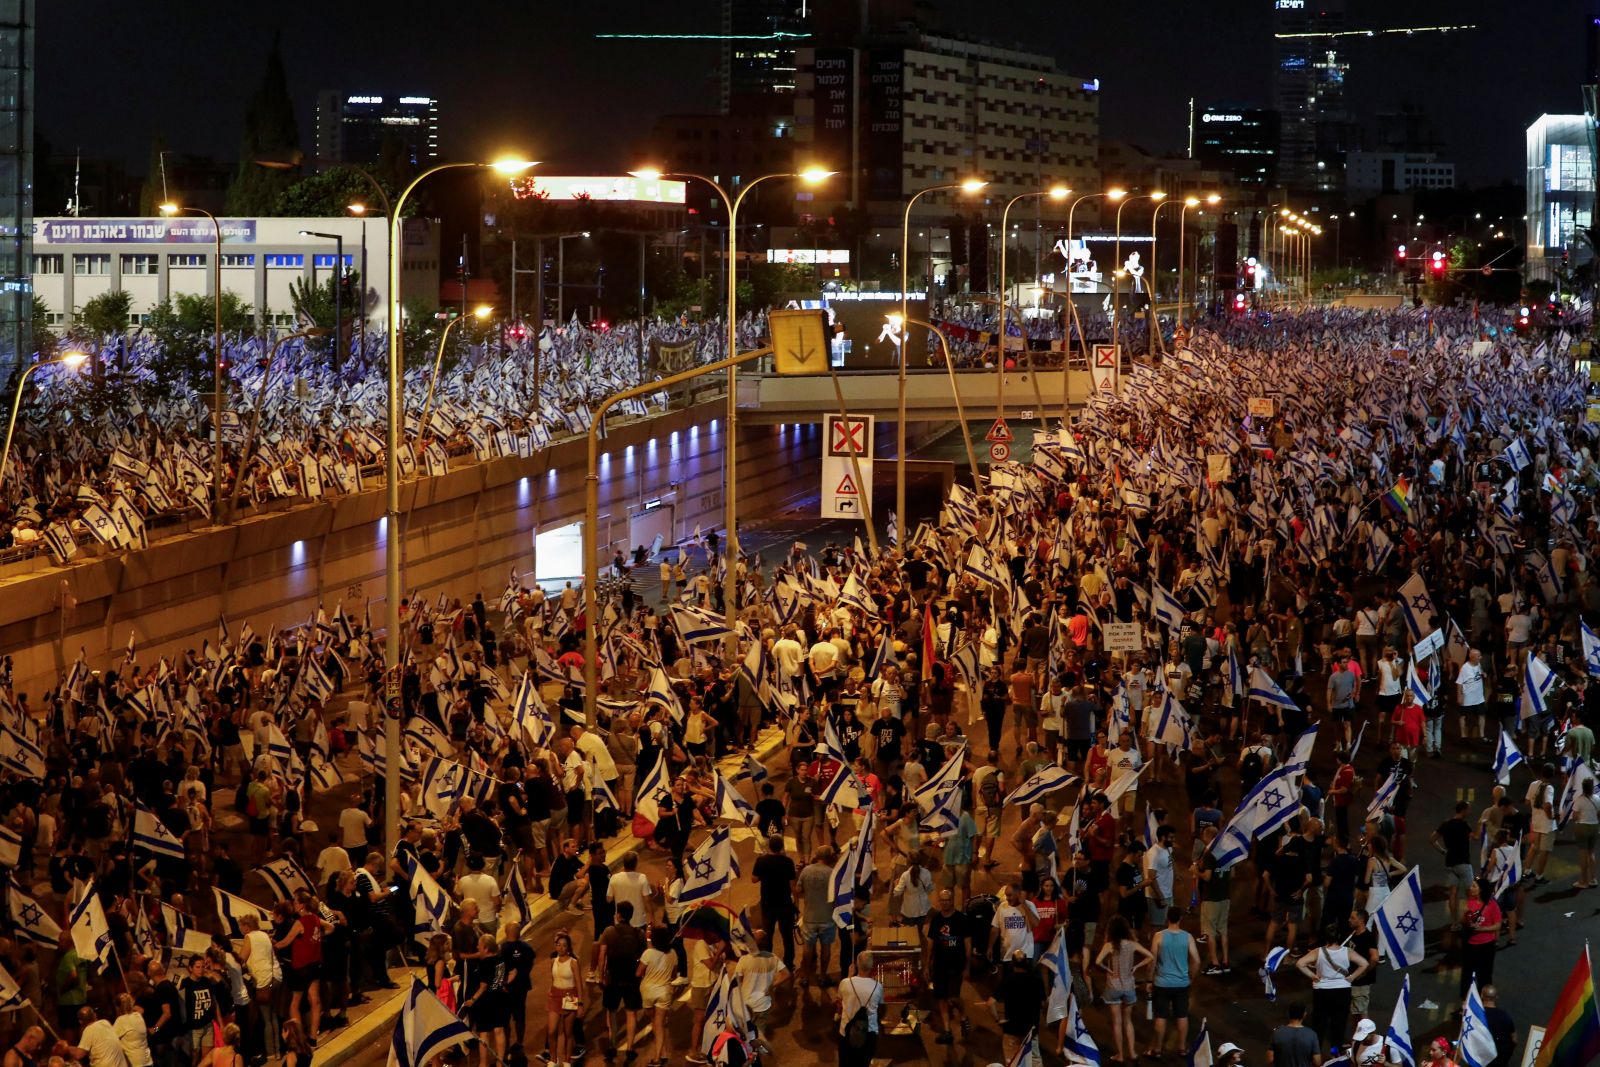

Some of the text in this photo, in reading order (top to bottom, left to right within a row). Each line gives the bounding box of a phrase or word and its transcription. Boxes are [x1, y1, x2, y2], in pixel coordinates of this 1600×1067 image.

[816, 59, 845, 69] חייבים
[816, 75, 845, 85] לפתור
[830, 90, 845, 99] את
[833, 104, 845, 114] זה
[52, 225, 80, 239] חינם
[83, 224, 127, 239] באהבת
[130, 225, 165, 239] שבחר
[994, 448, 1005, 456] 30
